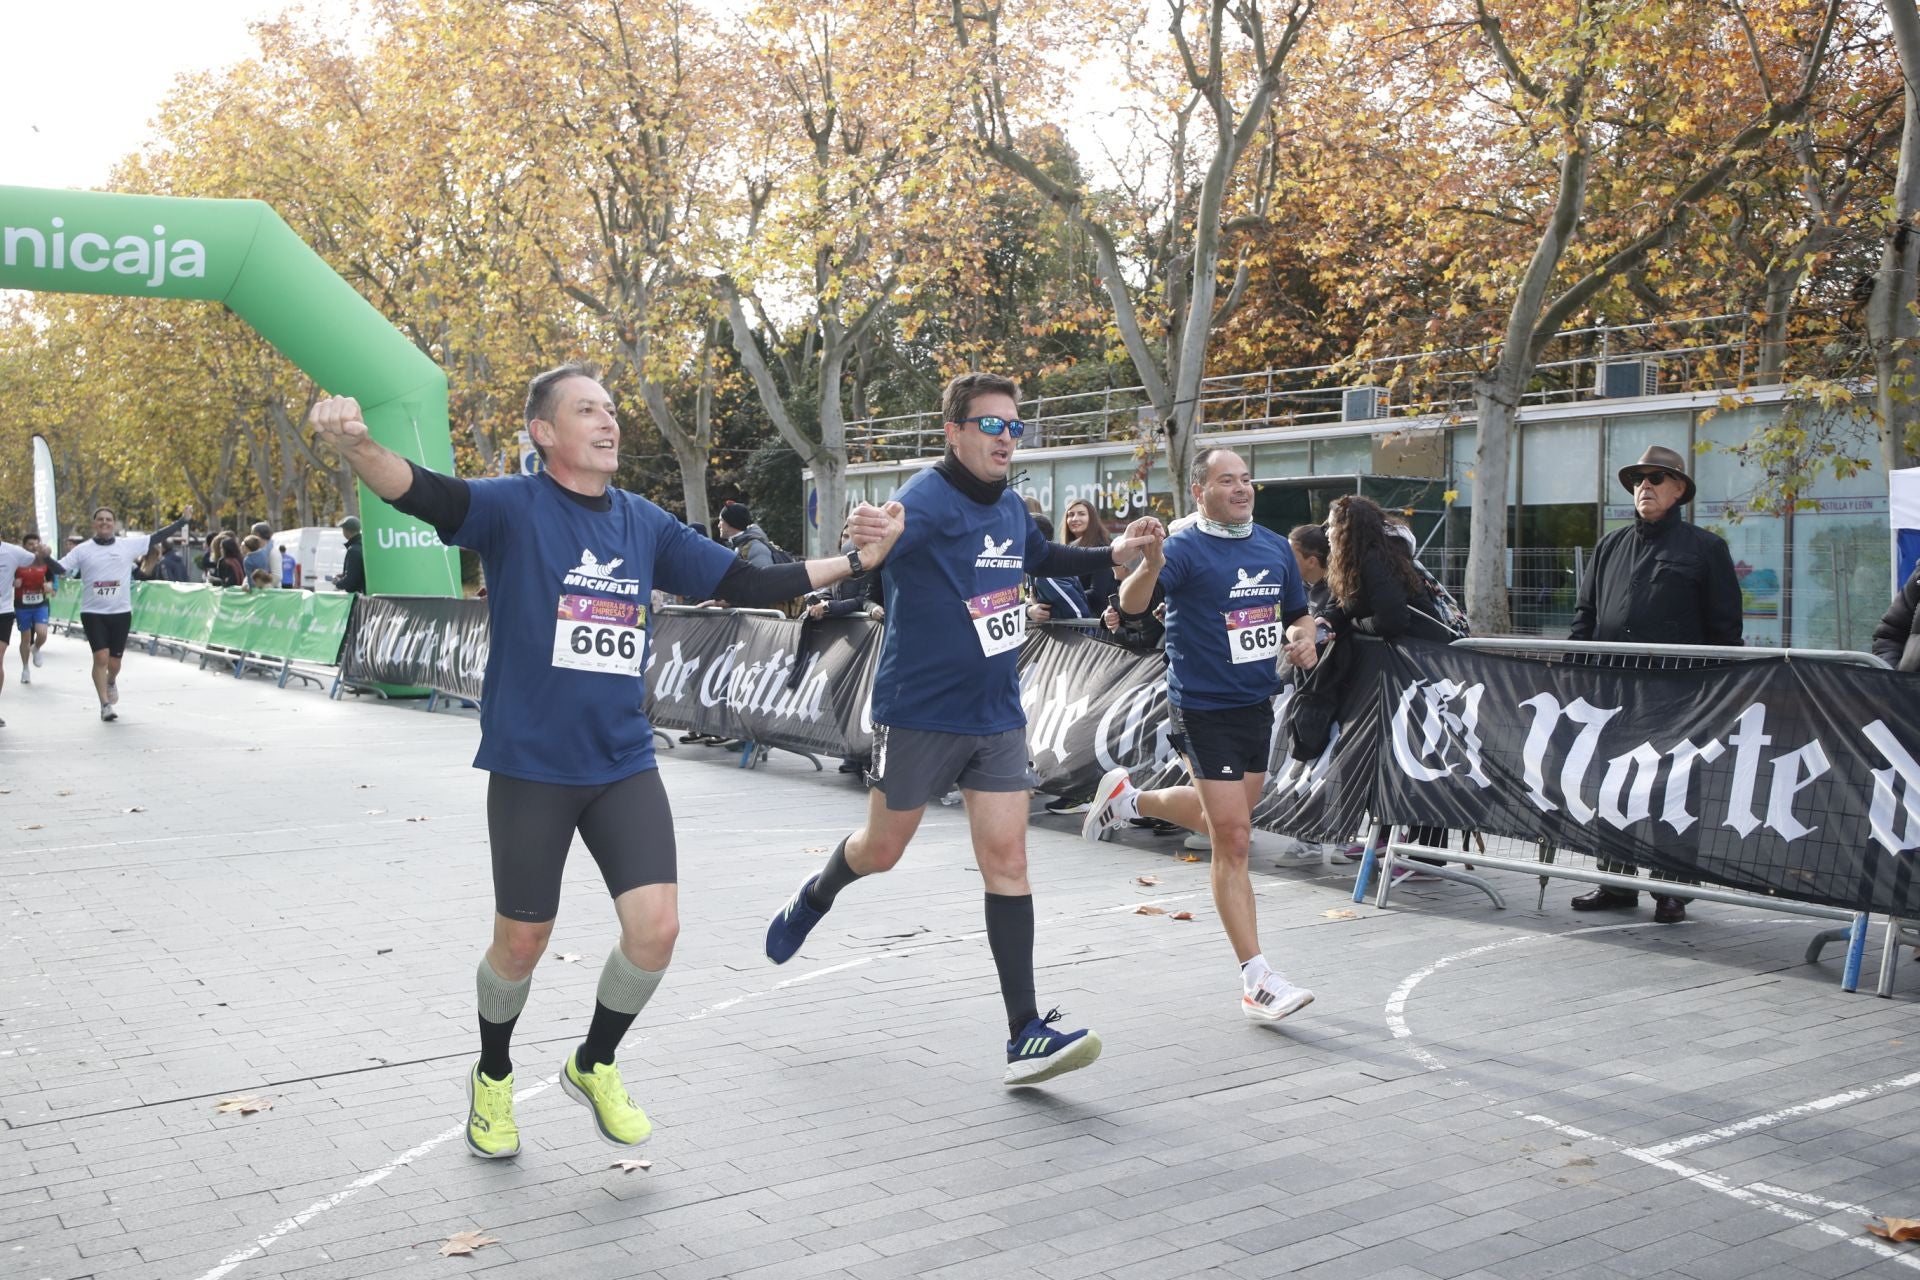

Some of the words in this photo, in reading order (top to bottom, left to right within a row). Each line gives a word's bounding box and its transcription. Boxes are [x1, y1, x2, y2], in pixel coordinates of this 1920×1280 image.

[4, 217, 206, 287] nicaja
[975, 558, 1022, 569] MICHELIN
[97, 587, 116, 596] 477
[563, 574, 639, 595] MICHELIN
[1229, 587, 1280, 599] MICHELIN
[592, 606, 626, 618] EMPRESAS
[986, 609, 1020, 641] 667
[570, 625, 635, 659] 666
[1239, 626, 1277, 651] 665
[653, 641, 700, 703] de
[1392, 679, 1491, 789] El
[1518, 692, 1831, 842] Norte
[1862, 719, 1920, 857] d
